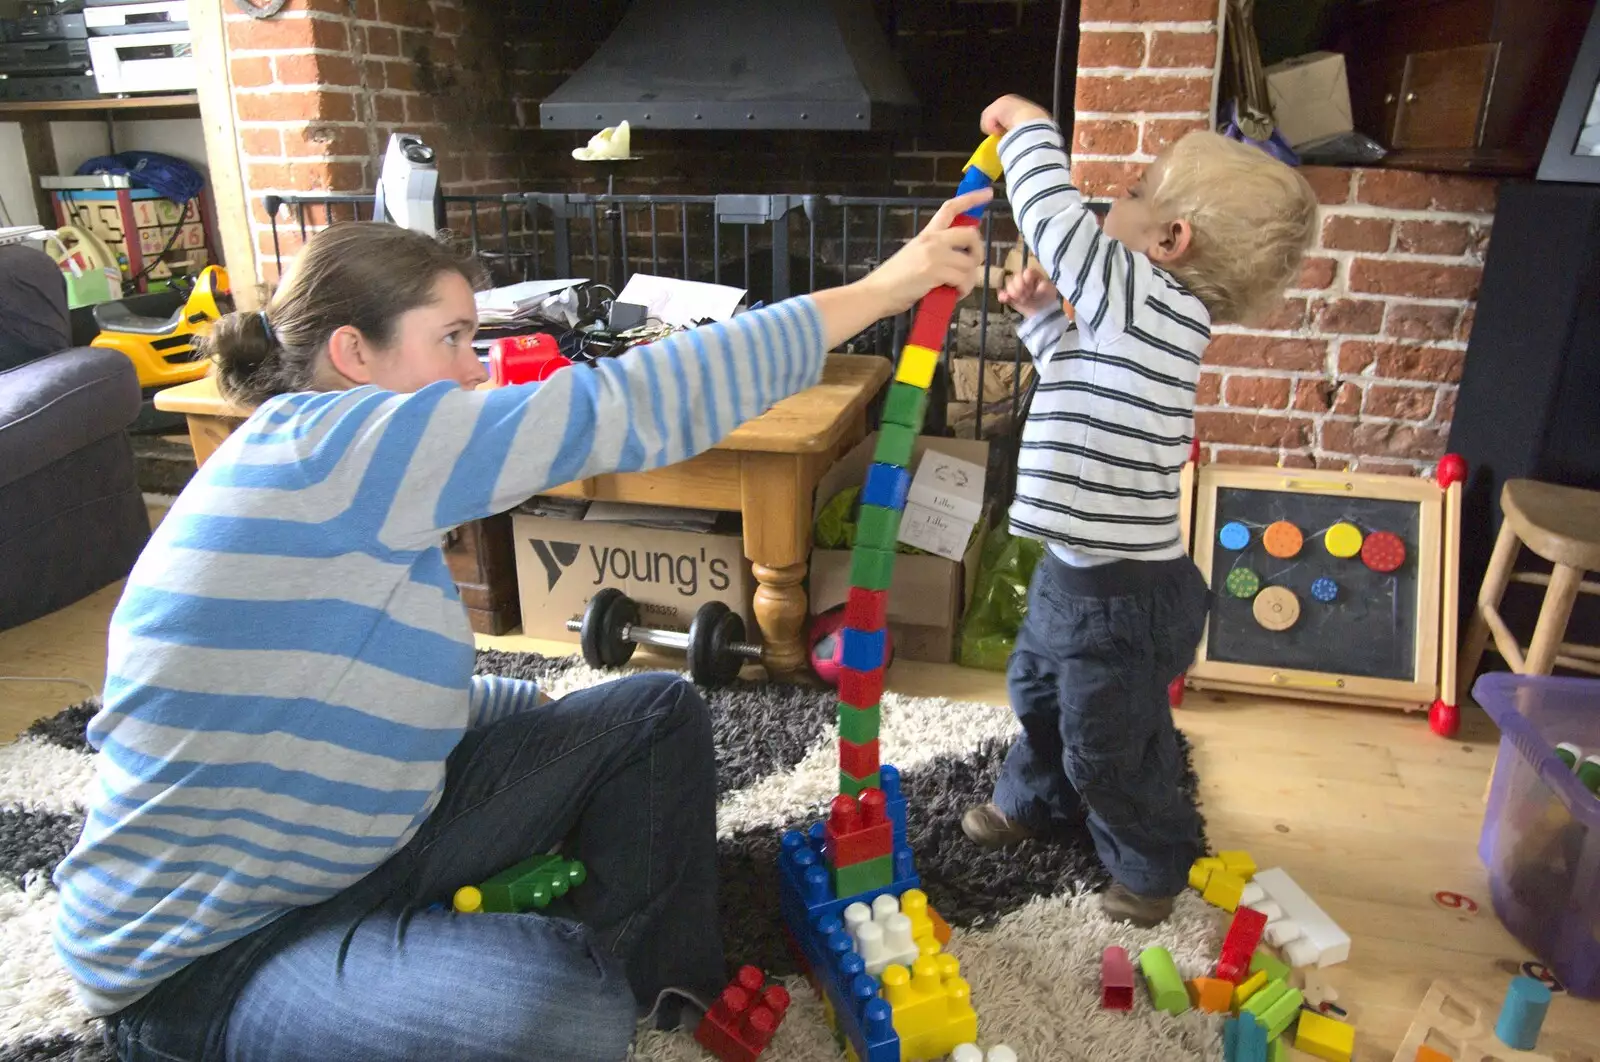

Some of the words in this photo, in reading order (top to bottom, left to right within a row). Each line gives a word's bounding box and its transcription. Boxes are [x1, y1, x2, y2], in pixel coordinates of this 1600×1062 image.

[140, 203, 151, 224] 1
[159, 201, 177, 220] 2
[589, 544, 730, 596] young's
